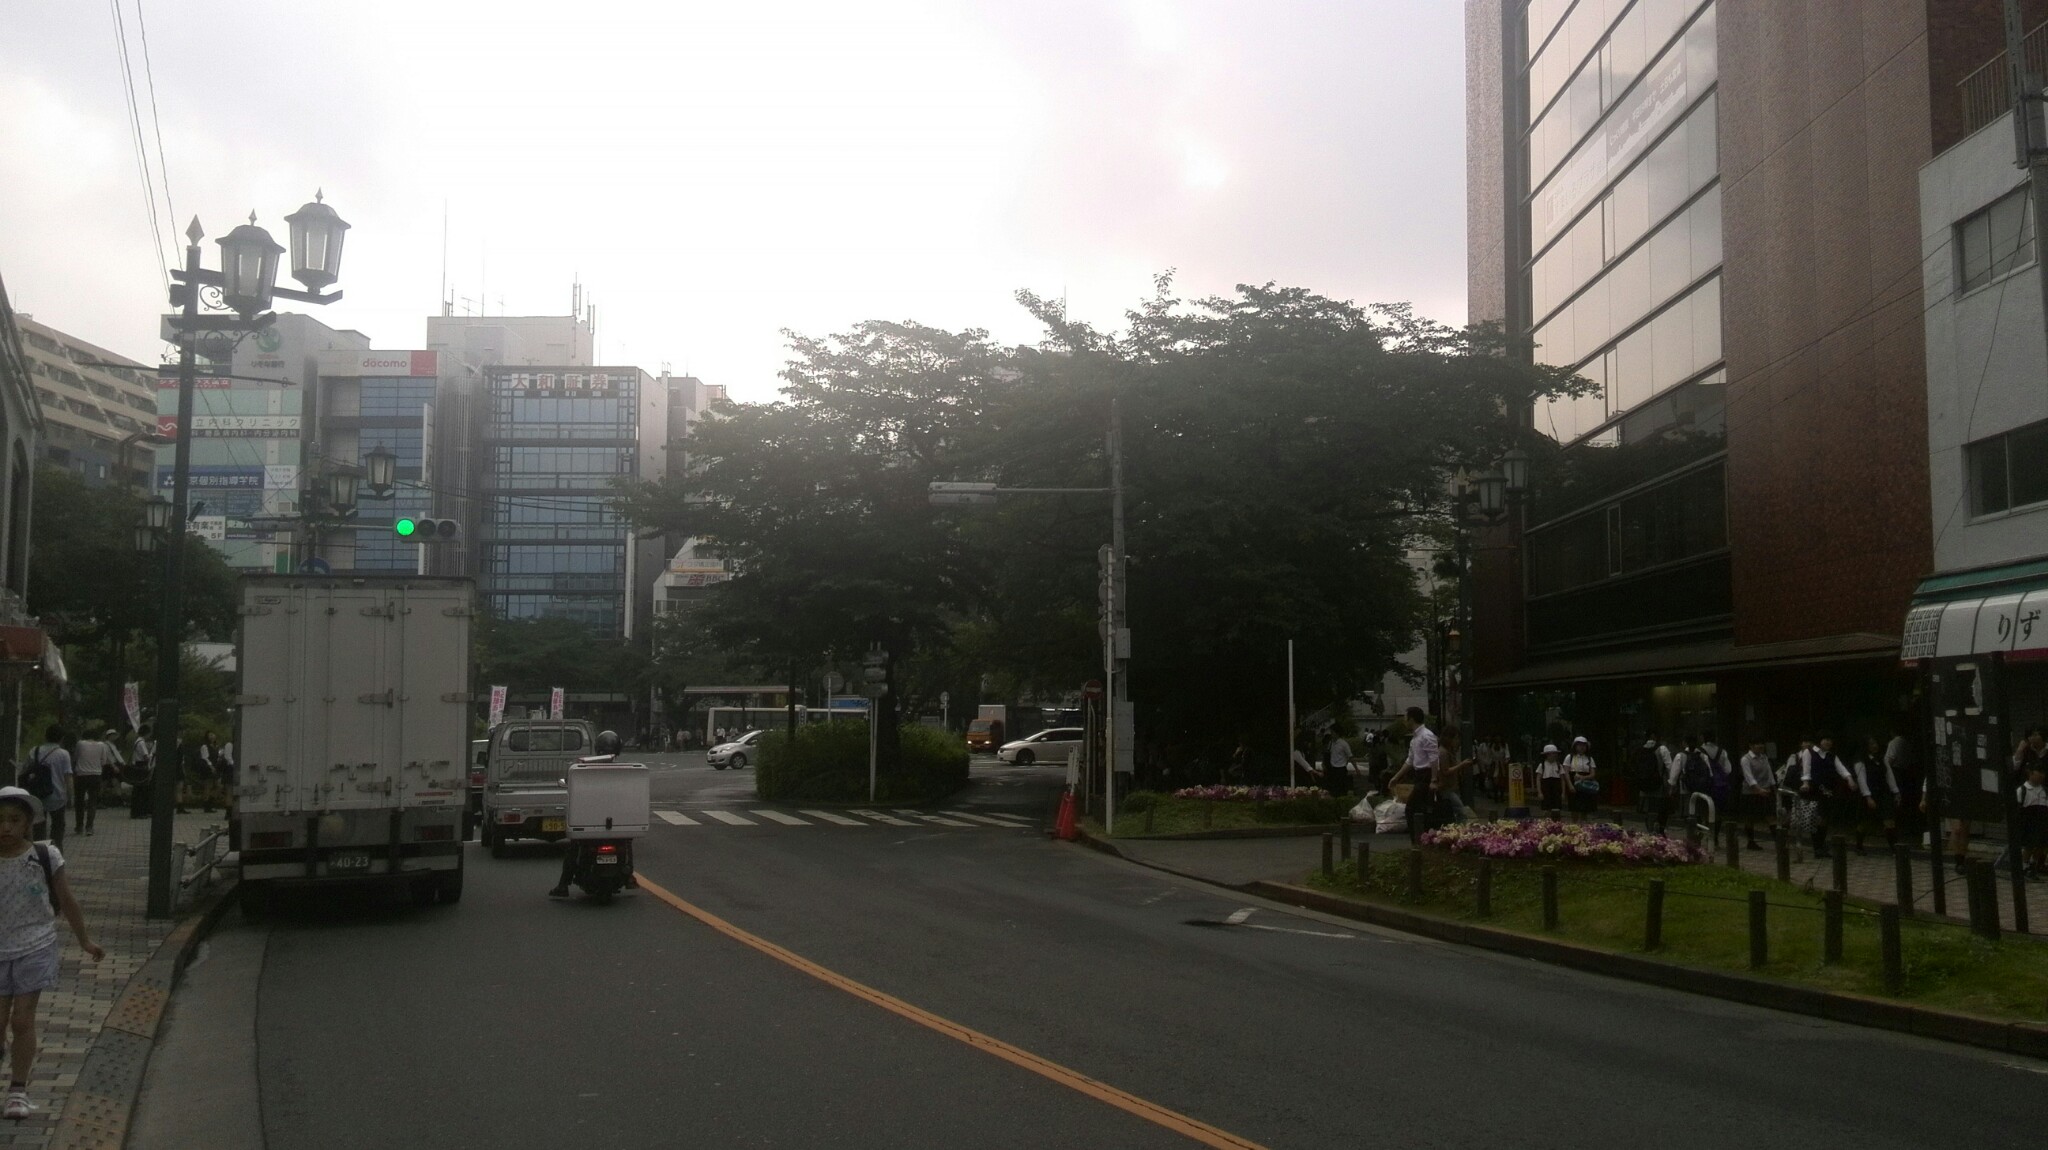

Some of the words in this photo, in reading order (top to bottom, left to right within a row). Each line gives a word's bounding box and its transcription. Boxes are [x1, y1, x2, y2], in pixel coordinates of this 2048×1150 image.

[362, 357, 407, 368] docomo
[512, 373, 608, 389] 大和証券
[195, 418, 299, 427] 立内科クリニック
[188, 475, 259, 487] 京個別指導学院
[1998, 609, 2041, 643] りず
